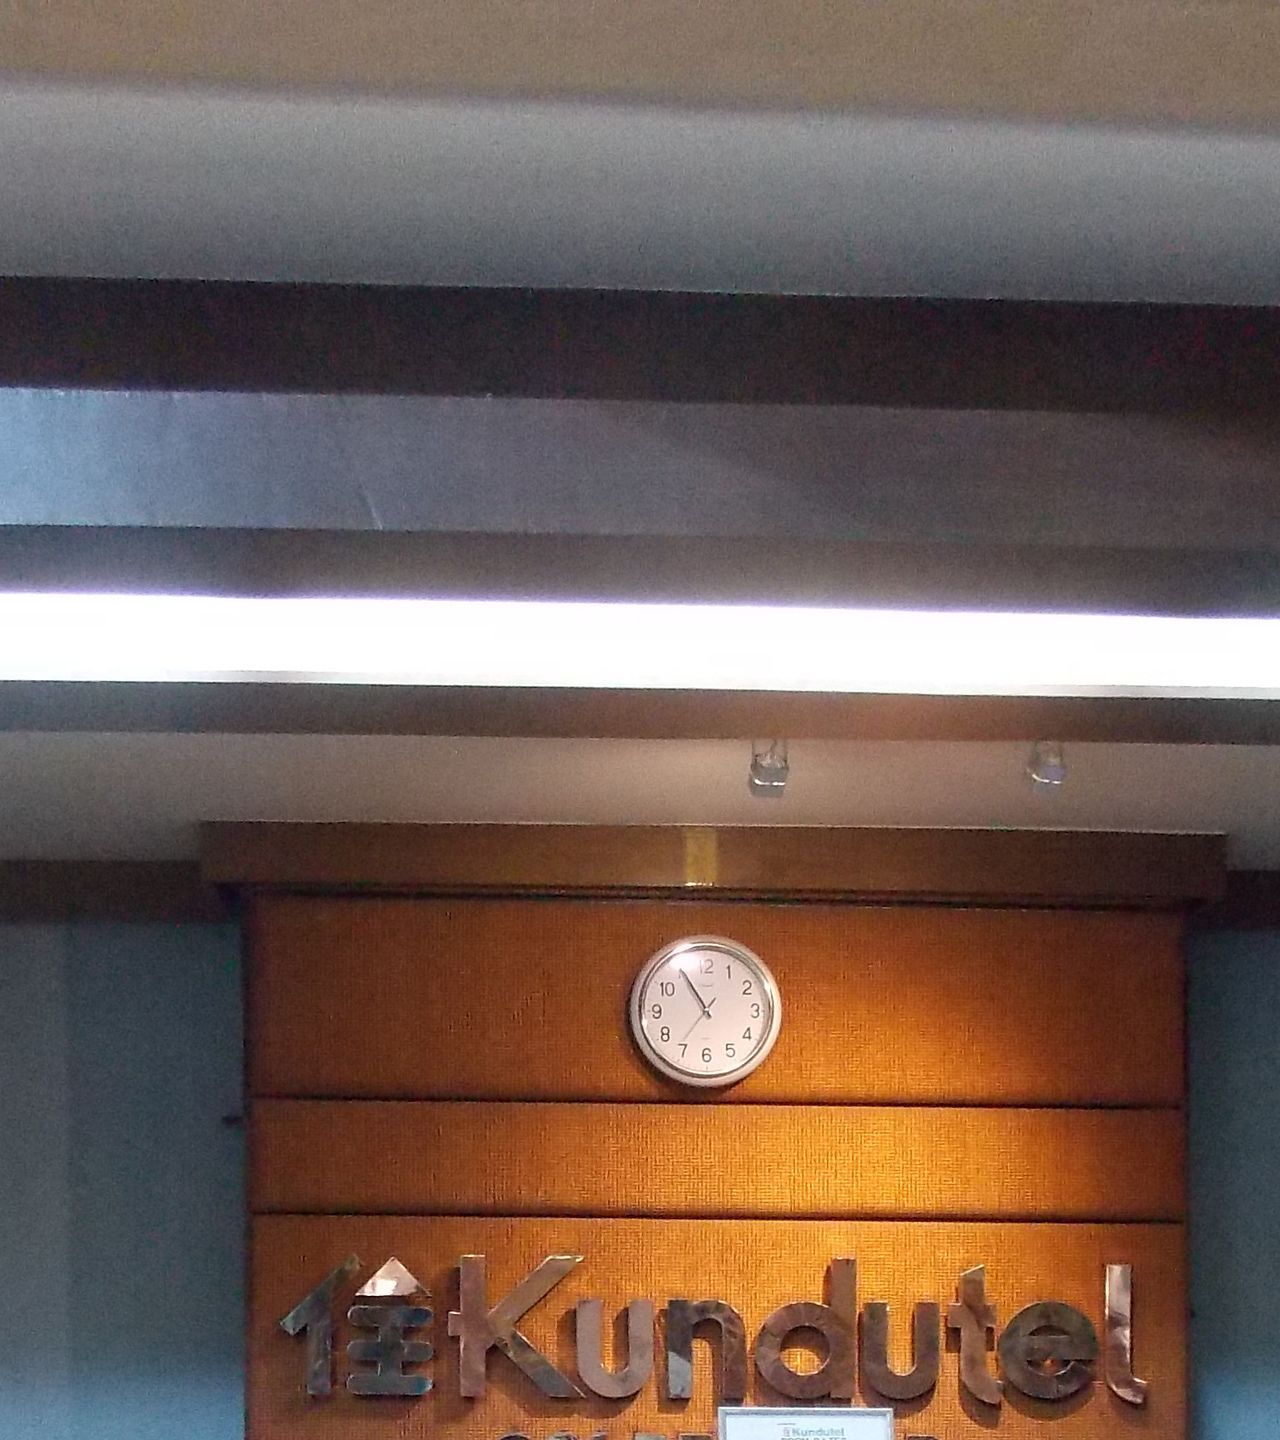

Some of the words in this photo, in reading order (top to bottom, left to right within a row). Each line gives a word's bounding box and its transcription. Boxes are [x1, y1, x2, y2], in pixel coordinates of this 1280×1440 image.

[699, 959, 714, 974] 12
[726, 965, 731, 979] 1
[660, 982, 675, 997] 10
[742, 980, 752, 995] 2
[651, 1003, 662, 1019] 9
[750, 1003, 760, 1018] 3
[660, 1026, 670, 1042] 8
[742, 1027, 752, 1040] 4
[678, 1043, 688, 1058] 7
[701, 1047, 712, 1062] 6
[725, 1043, 736, 1057] 5
[448, 1254, 1148, 1405] Kundutel
